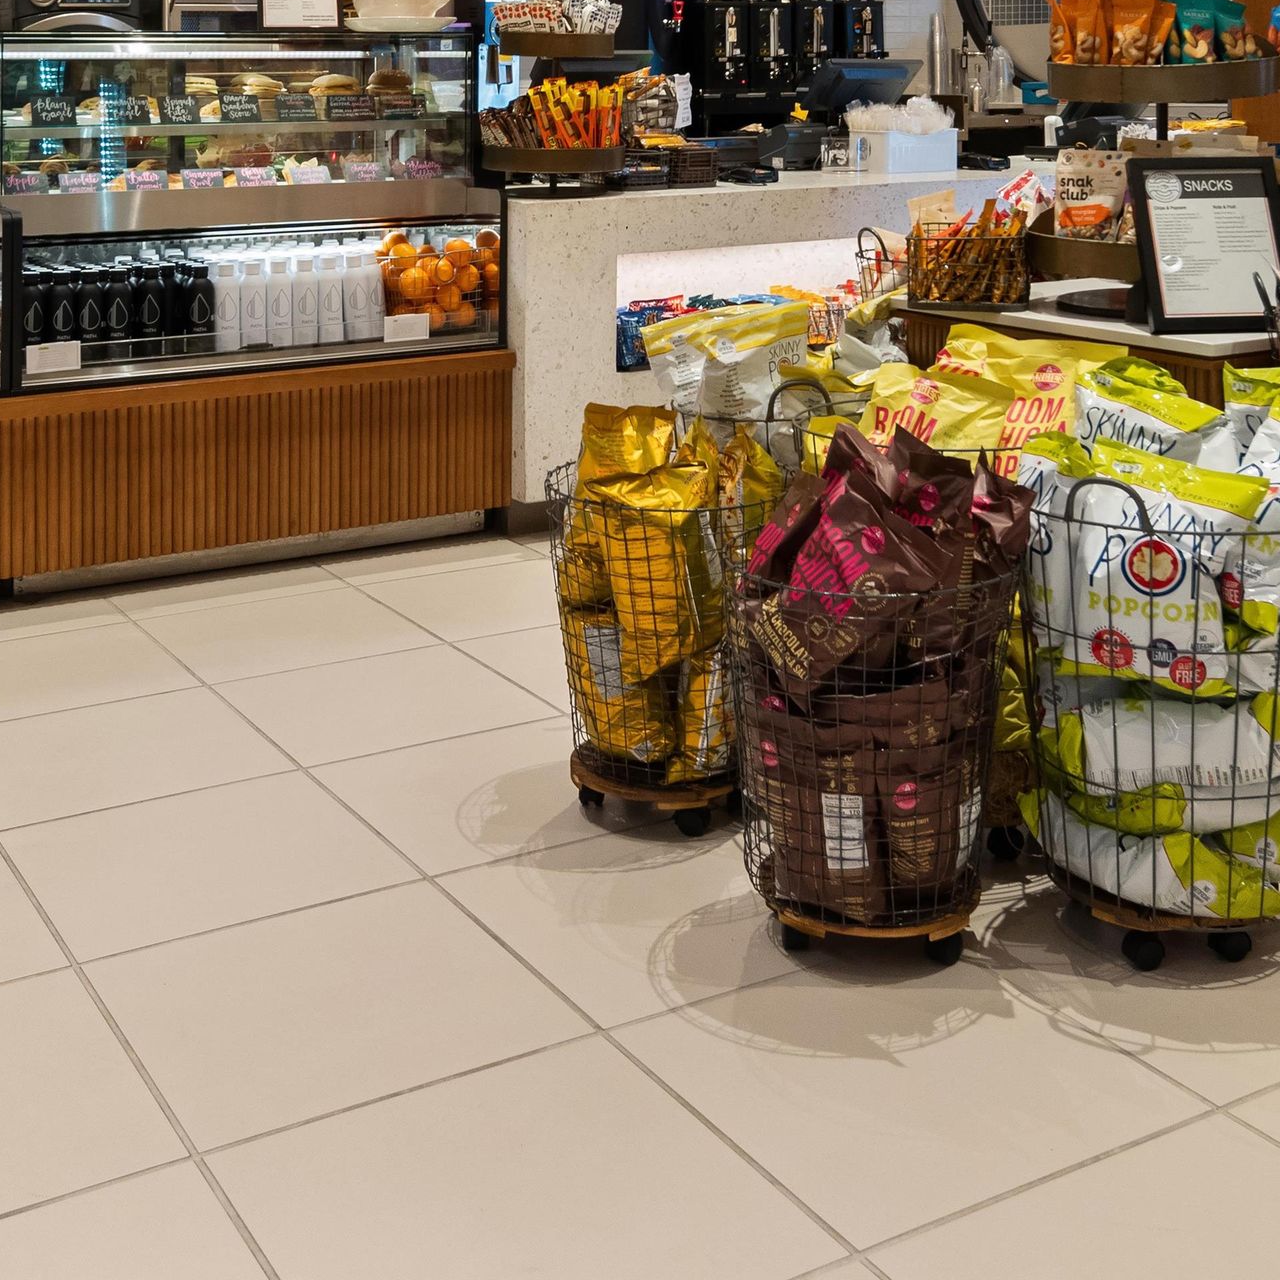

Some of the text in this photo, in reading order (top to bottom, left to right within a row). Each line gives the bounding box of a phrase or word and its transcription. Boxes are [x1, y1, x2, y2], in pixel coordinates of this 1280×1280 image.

[1060, 175, 1095, 188] snak
[1183, 179, 1234, 192] SNACKS
[1060, 188, 1089, 201] club
[769, 339, 802, 360] SKINNY
[912, 383, 943, 404] NGIE'S
[1006, 396, 1066, 425] OOM
[1088, 590, 1220, 622] POPCORN
